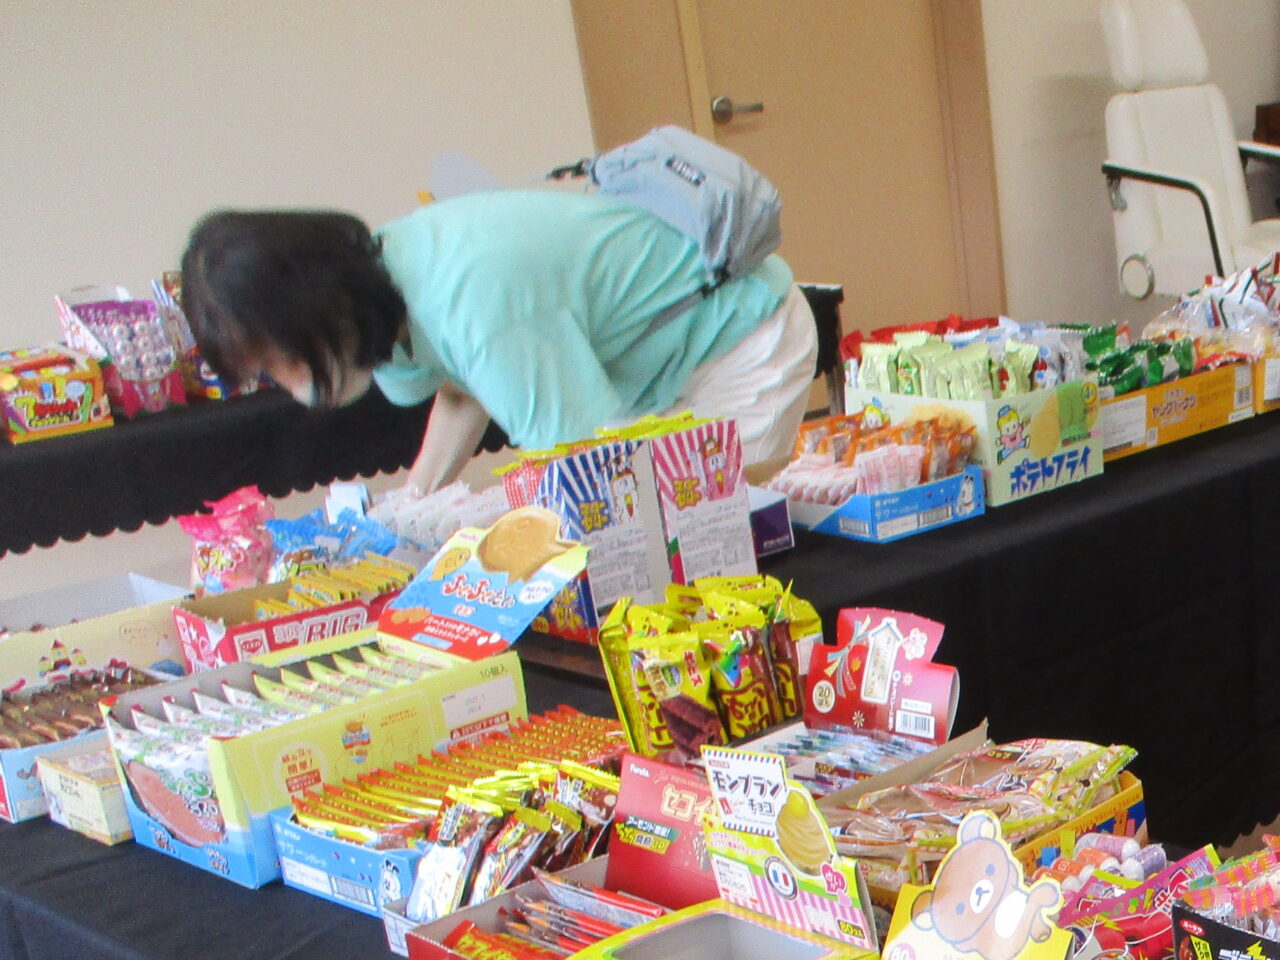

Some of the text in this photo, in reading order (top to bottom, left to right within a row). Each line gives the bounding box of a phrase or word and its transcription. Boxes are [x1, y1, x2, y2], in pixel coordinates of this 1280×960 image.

[1010, 446, 1091, 499] ポテトフライ
[712, 769, 781, 798] モンブラン
